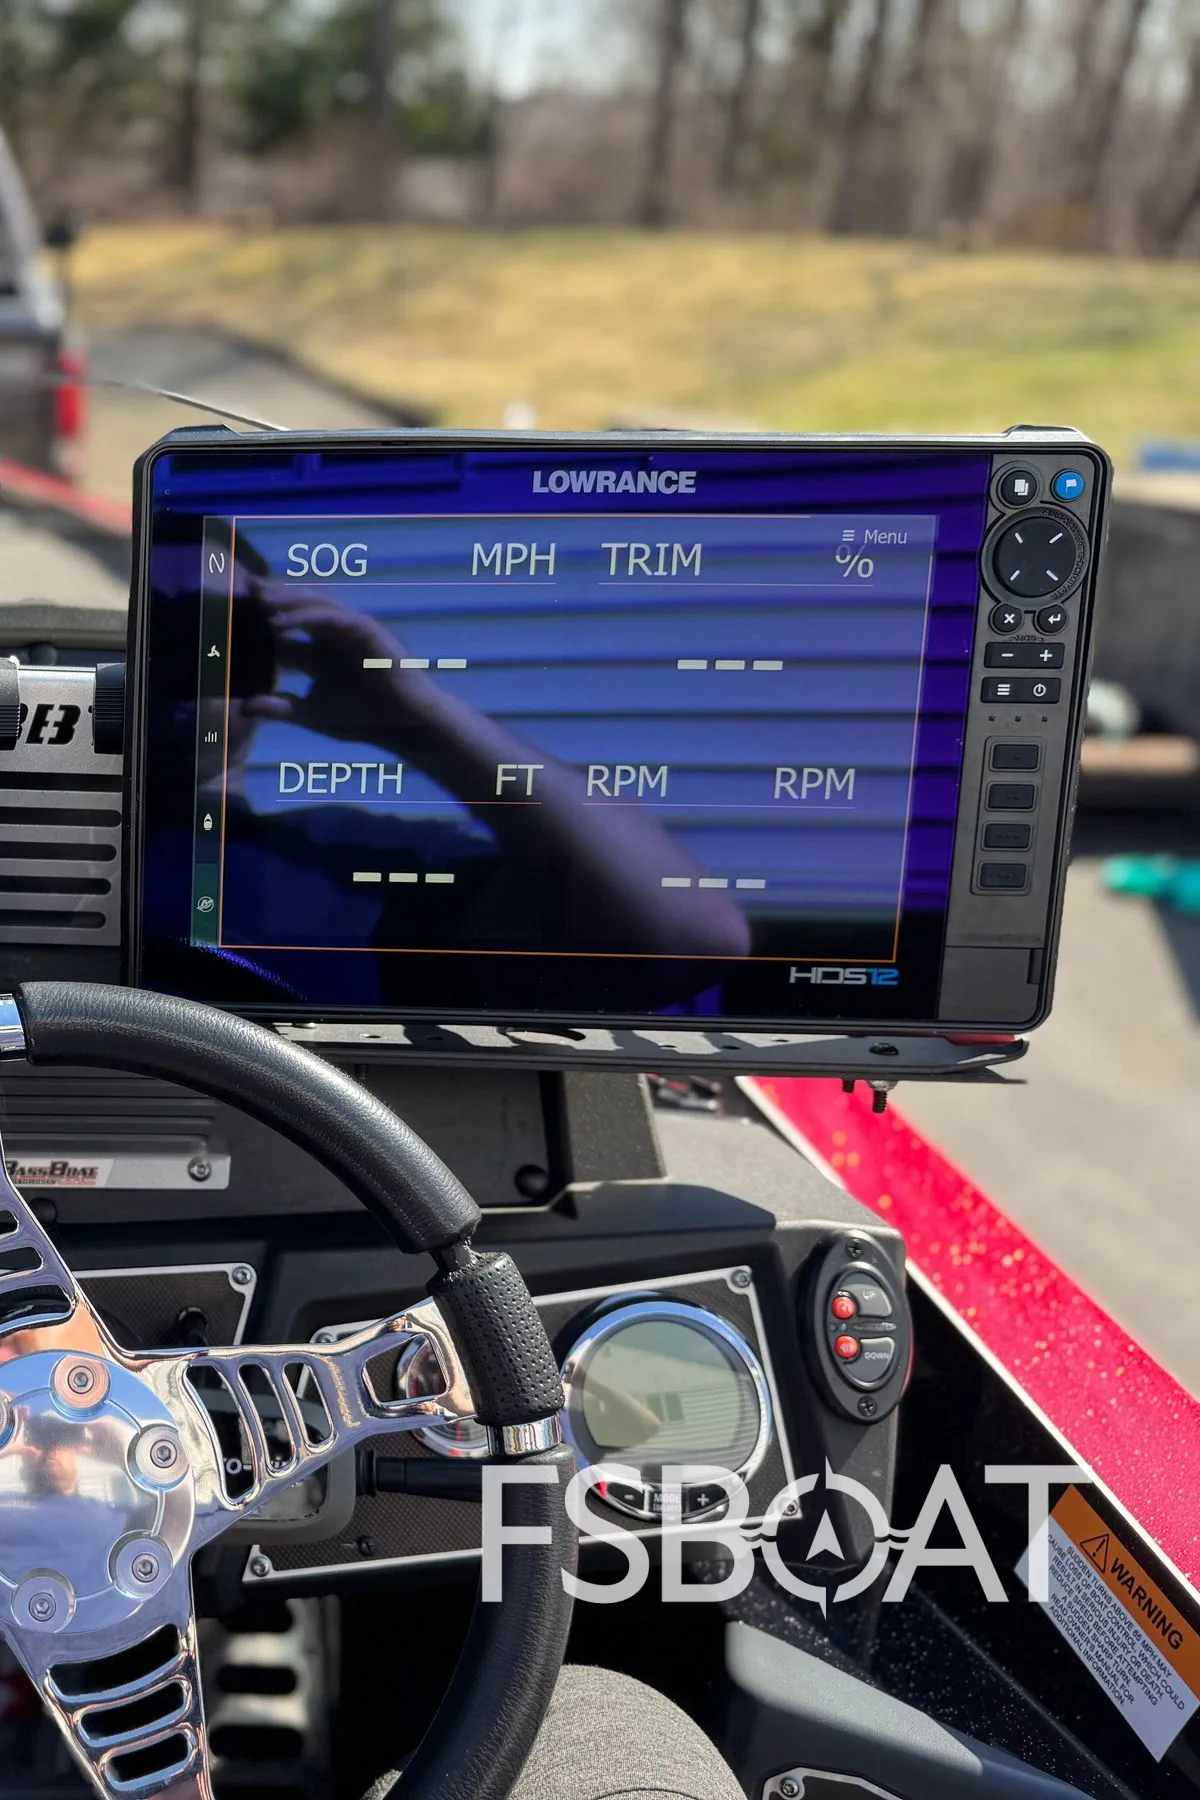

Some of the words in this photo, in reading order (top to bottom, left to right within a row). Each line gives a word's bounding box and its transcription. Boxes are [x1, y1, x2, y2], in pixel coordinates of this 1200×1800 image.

[533, 470, 696, 494] LOWRANCE
[864, 528, 907, 545] Menu
[286, 543, 368, 577] SOG
[471, 542, 556, 576] MPH
[601, 542, 702, 577] TRIM
[835, 544, 874, 578] %
[278, 761, 403, 795] DEPTH
[495, 764, 544, 796] FT
[587, 765, 668, 798] RPM
[774, 767, 855, 800] RPM
[789, 966, 898, 985] HDS12
[864, 1351, 889, 1360] DOWN
[1046, 1533, 1067, 1561] CAUSE
[1065, 1557, 1082, 1580] LOSS
[1080, 1577, 1091, 1592] OF
[1089, 1588, 1108, 1613] BOAT
[1137, 1649, 1161, 1681] WHICH
[1159, 1677, 1185, 1711] COULD
[1052, 1555, 1075, 1586] RESULT
[1073, 1582, 1082, 1594] IN
[1080, 1591, 1108, 1628] SERIOUS
[1107, 1625, 1131, 1657] INJURY
[1129, 1654, 1141, 1671] OR
[1066, 1545, 1092, 1579] SUDDEN
[1090, 1575, 1112, 1604] TURNS
[1110, 1601, 1134, 1631] ABOVE
[1140, 1638, 1157, 1661] MPH
[1155, 1657, 1172, 1679] MAY
[1108, 1556, 1184, 1652] WARNING
[1048, 1603, 1084, 1651] ADDITIONAL
[1048, 1564, 1074, 1597] REDUCE
[1072, 1594, 1094, 1623] SPEED
[1092, 1620, 1118, 1655] BEFORE
[1116, 1651, 1158, 1706] ATTEMPTING
[1050, 1593, 1068, 1617] READ
[1066, 1613, 1095, 1652] OWNER'S
[1094, 1650, 1121, 1686] MANUAL
[1061, 1593, 1068, 1603] A
[1066, 1600, 1092, 1635] SUDDEN
[1090, 1631, 1113, 1662] SHARP
